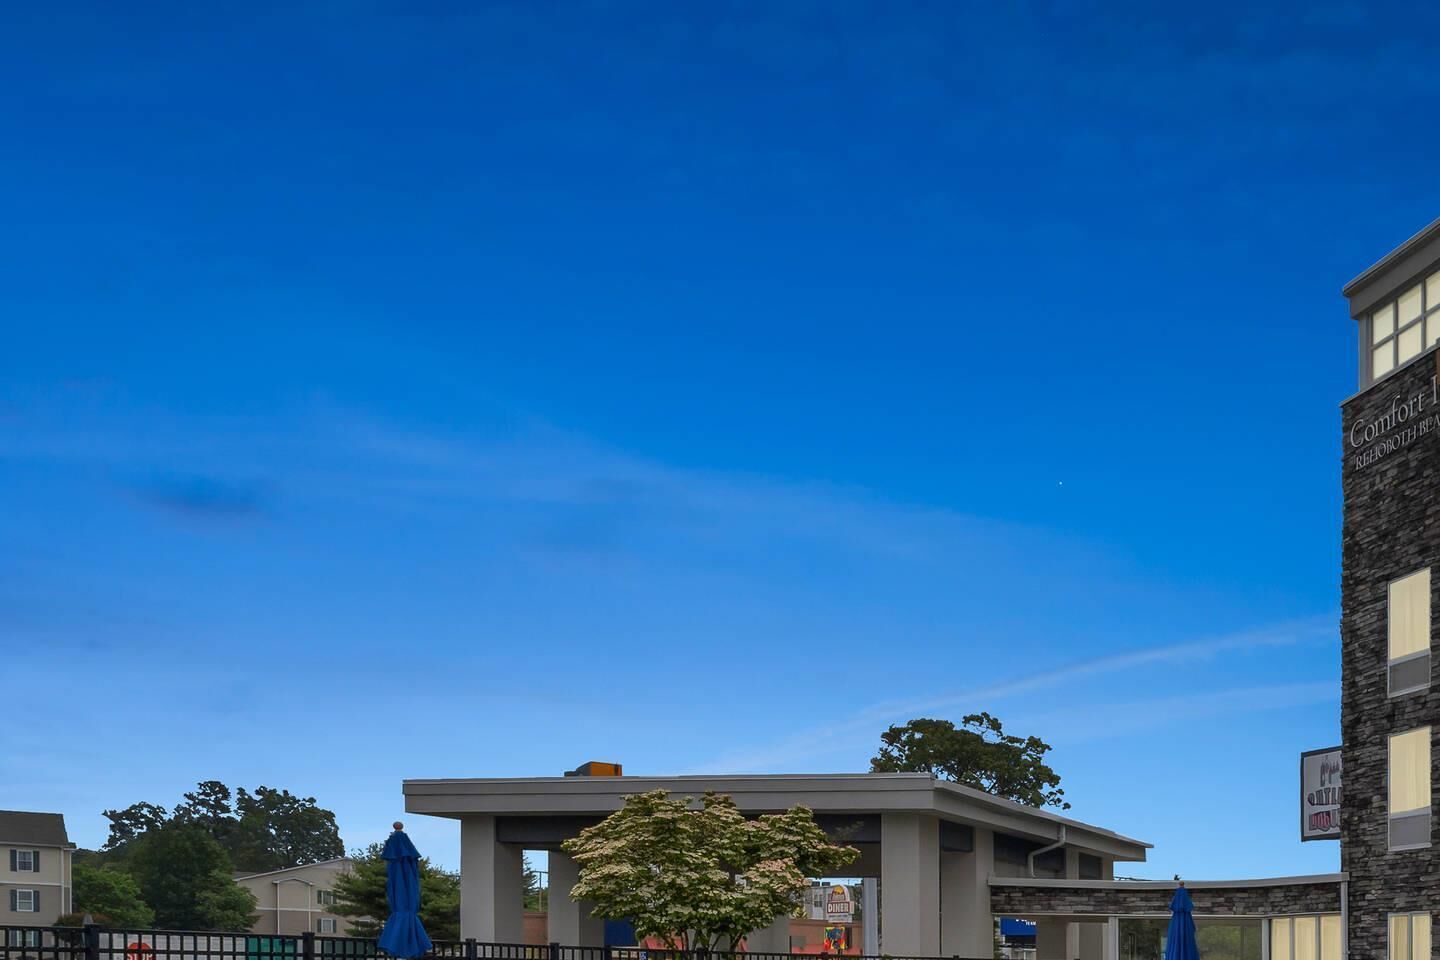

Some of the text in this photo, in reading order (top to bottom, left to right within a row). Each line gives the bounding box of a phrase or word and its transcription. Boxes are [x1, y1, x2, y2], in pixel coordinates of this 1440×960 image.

[1350, 392, 1425, 448] Comfort
[1355, 425, 1417, 470] REHOBOTH
[827, 903, 849, 913] DINER
